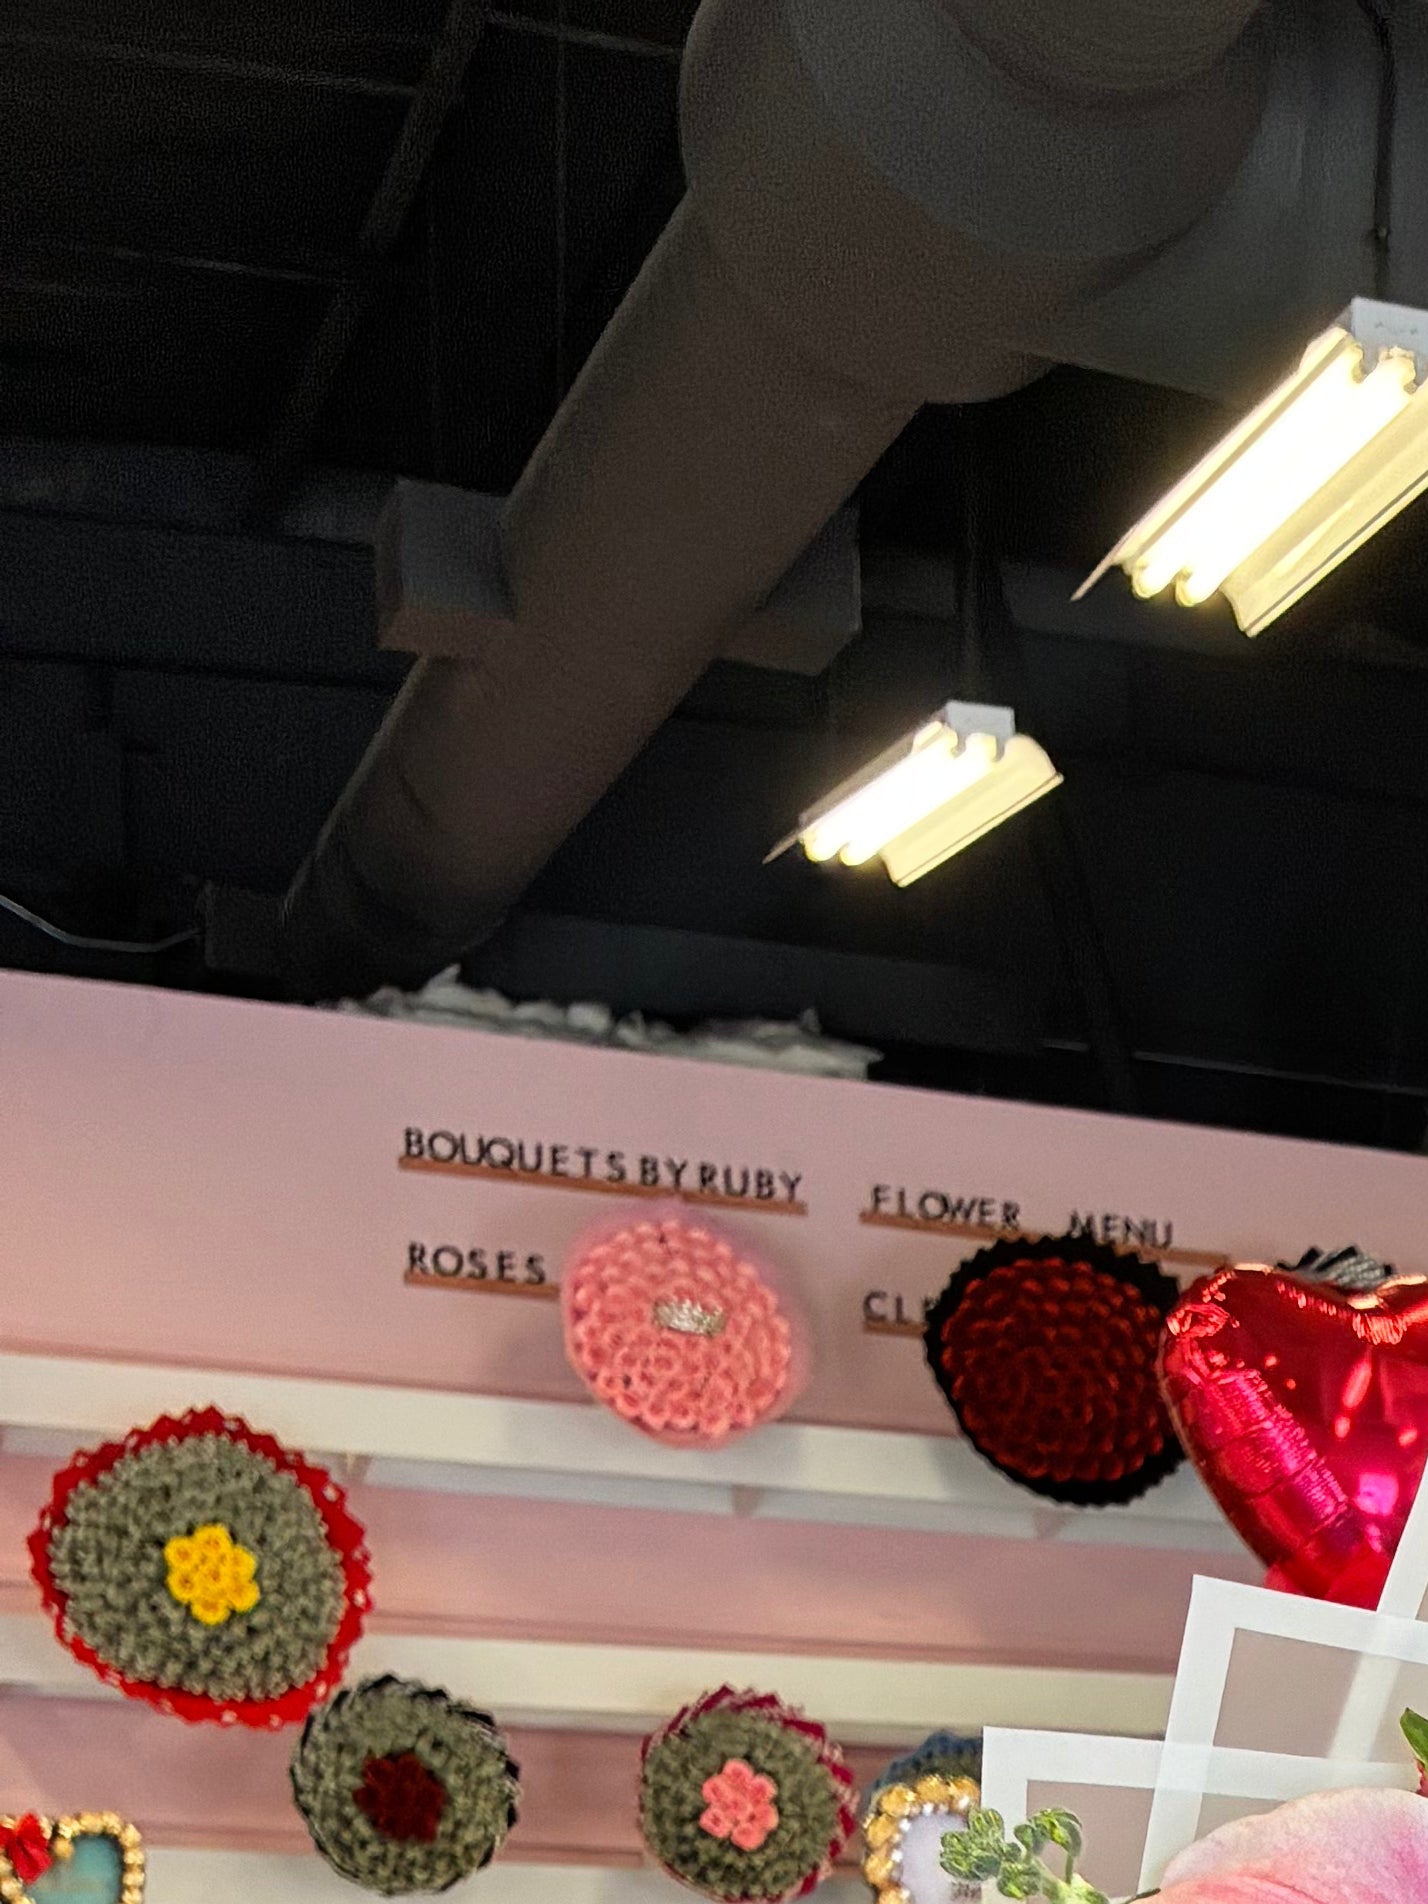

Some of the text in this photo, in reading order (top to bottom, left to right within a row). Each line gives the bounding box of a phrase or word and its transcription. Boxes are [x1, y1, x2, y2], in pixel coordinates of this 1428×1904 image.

[404, 1127, 803, 1203] BOUQUETS BY RUBY
[872, 1184, 1173, 1250] FLOWER MENU
[408, 1242, 547, 1286] ROSES
